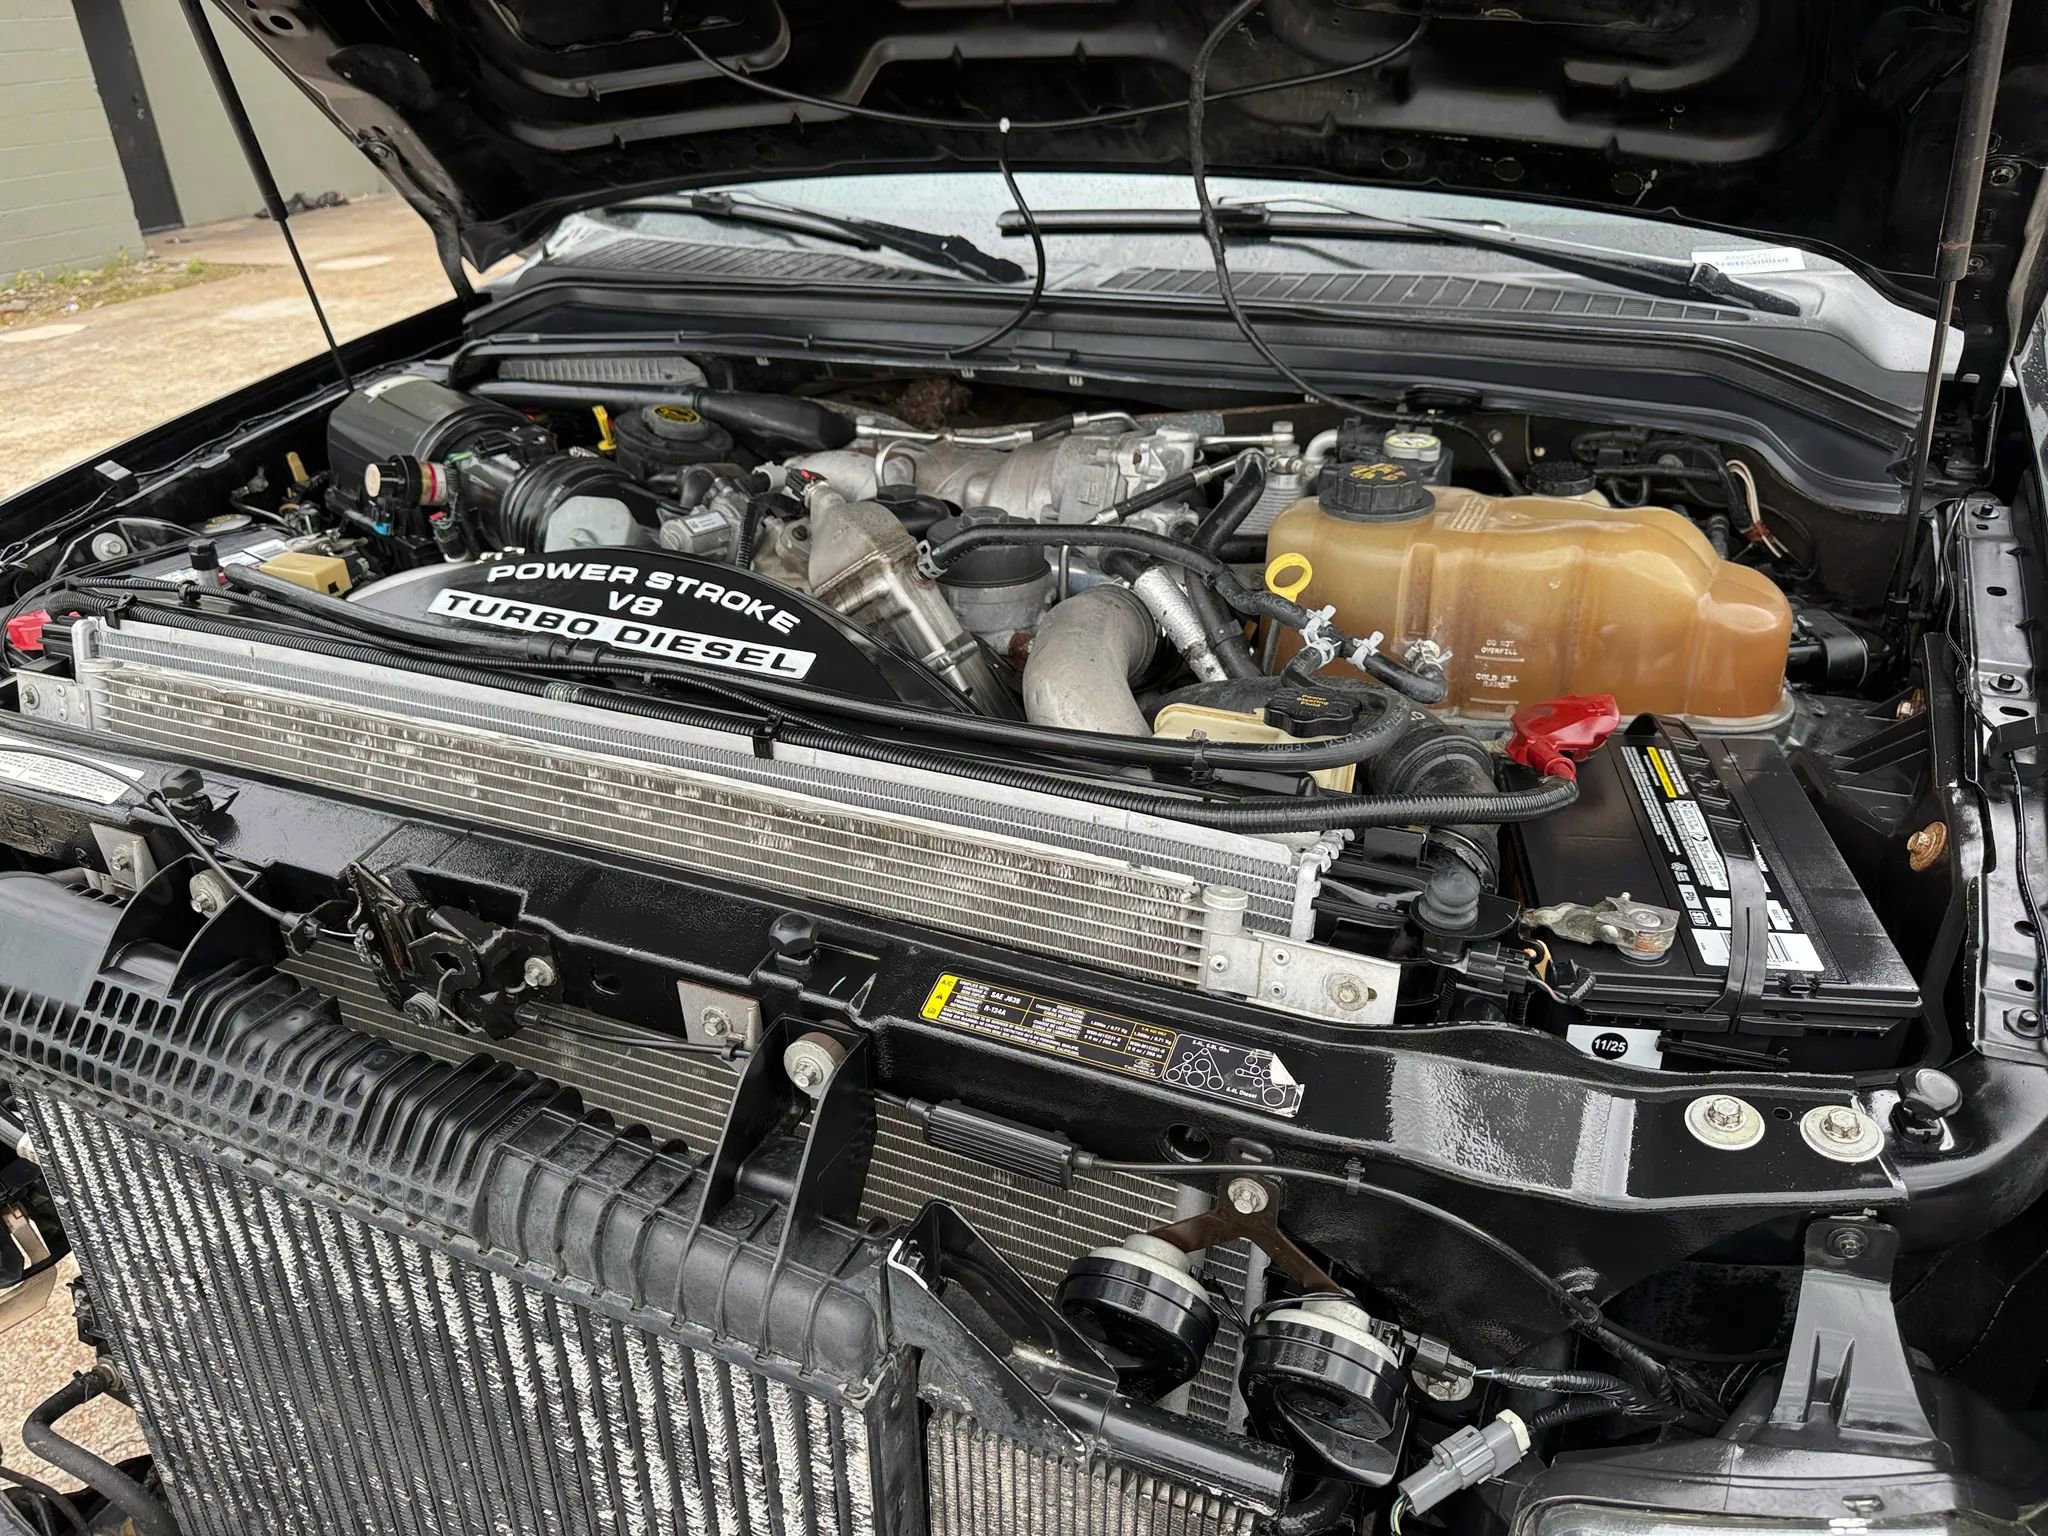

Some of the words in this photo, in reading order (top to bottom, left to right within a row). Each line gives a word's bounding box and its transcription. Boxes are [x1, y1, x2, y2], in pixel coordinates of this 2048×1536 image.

[486, 562, 638, 583] POWER
[645, 570, 801, 636] STROKE
[607, 590, 664, 618] V8
[446, 594, 600, 636] TURBO
[614, 625, 798, 673] DIESEL
[1475, 672, 1498, 682] COLD
[990, 991, 1004, 1000] SAE
[1004, 996, 1021, 1004] J639
[983, 1004, 1007, 1016] R-134A
[1218, 1046, 1230, 1054] Gas
[1594, 1038, 1627, 1053] 11/25
[1239, 1089, 1257, 1099] Diesel
